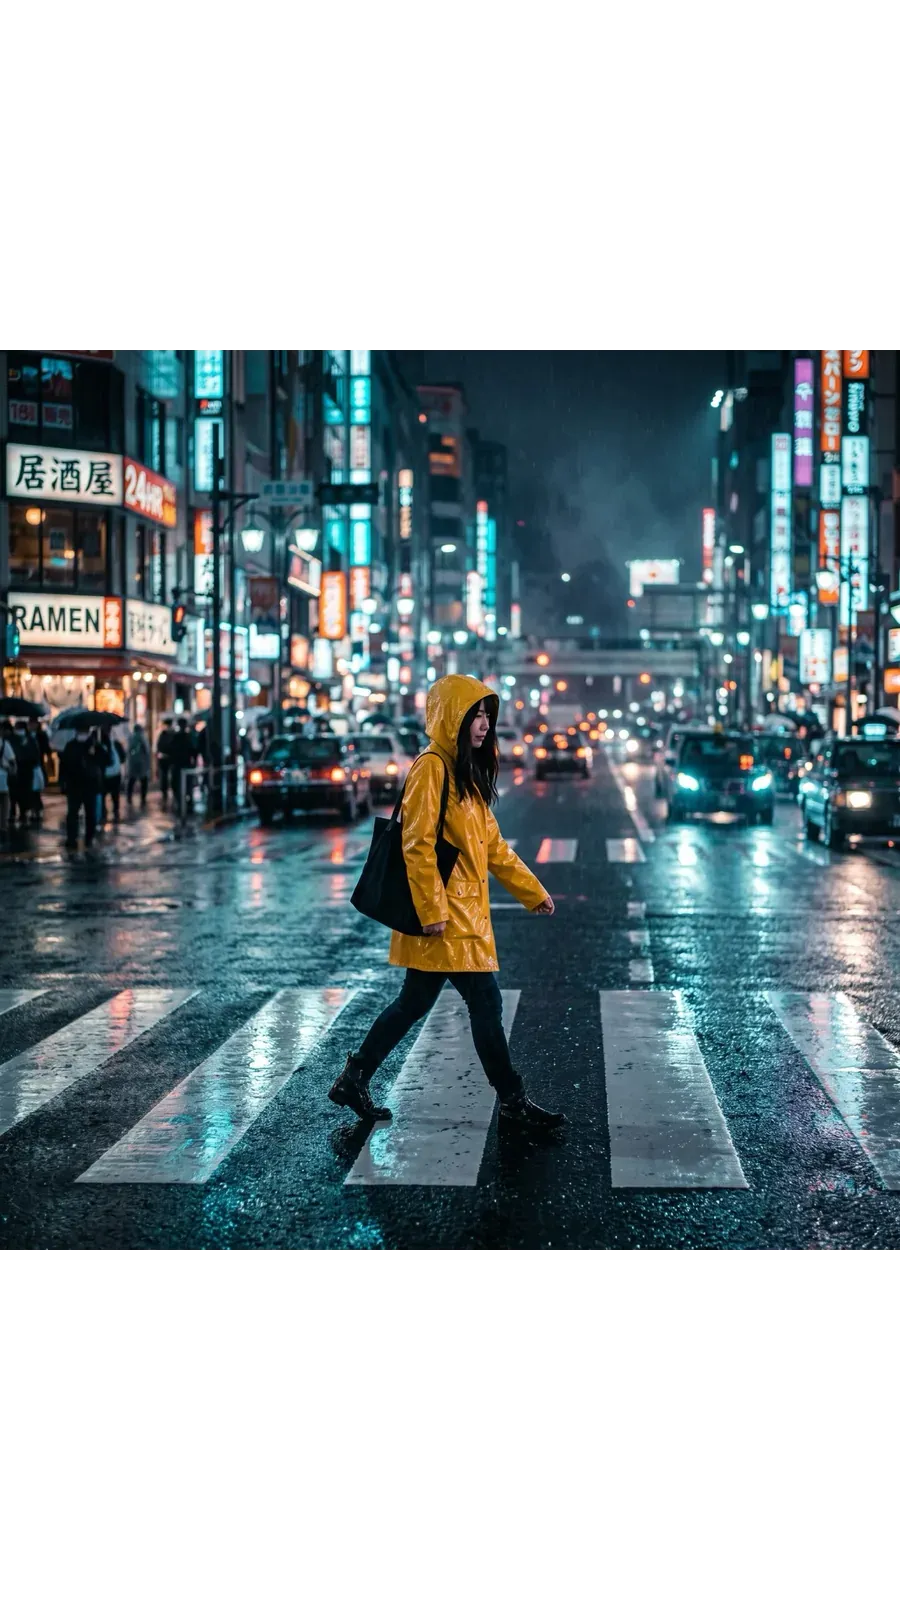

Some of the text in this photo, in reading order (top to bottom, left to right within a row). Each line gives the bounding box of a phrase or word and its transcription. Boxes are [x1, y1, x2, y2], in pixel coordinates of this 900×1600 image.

[16, 455, 114, 495] 居酒屋
[125, 465, 163, 518] 24HR
[15, 605, 100, 632] RAMEN
